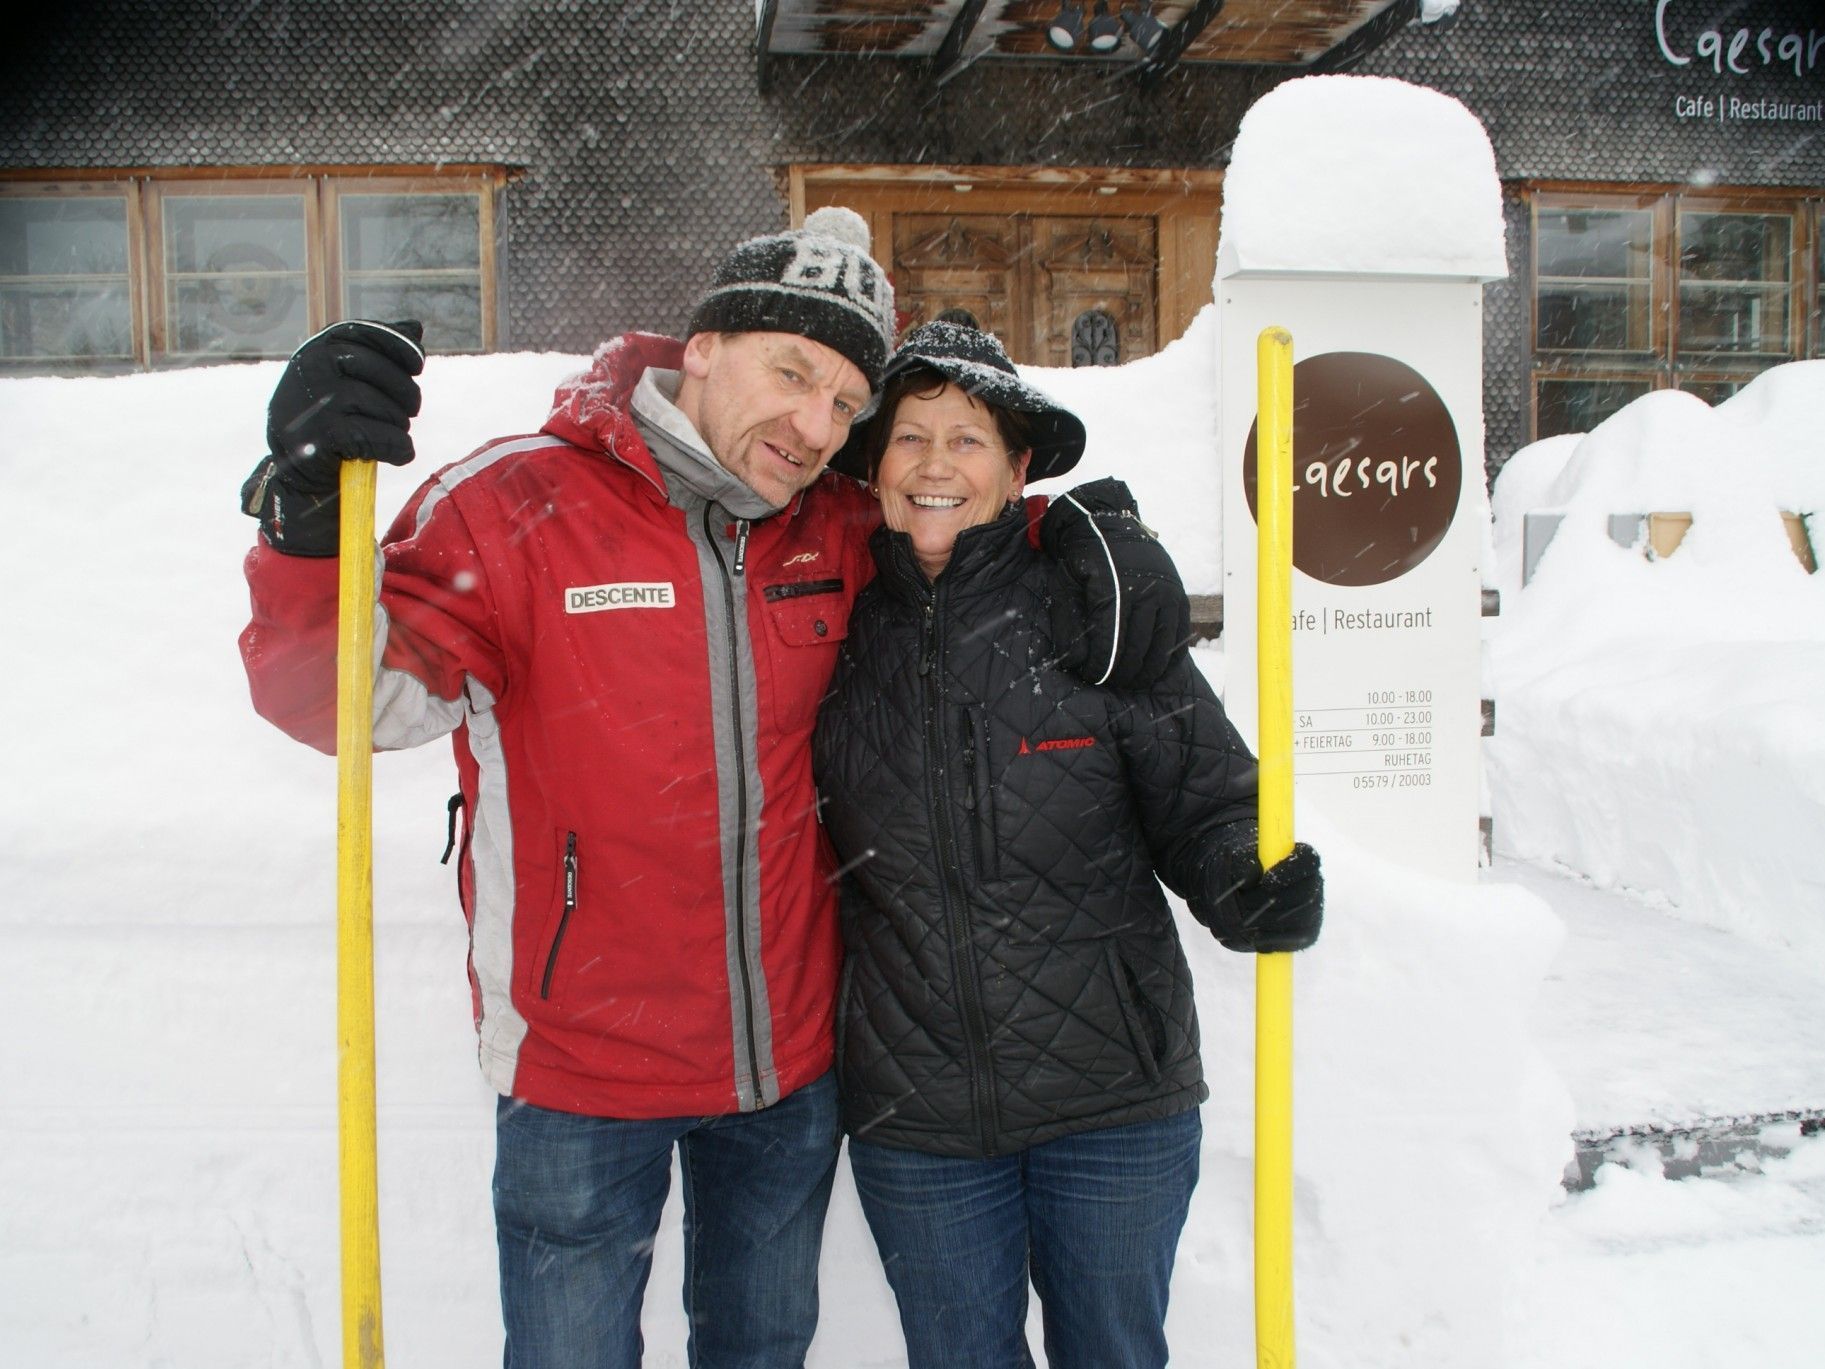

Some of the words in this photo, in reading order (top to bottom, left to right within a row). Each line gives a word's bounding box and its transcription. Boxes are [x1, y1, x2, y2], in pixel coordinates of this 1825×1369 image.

[1675, 95, 1714, 118] Cafe
[1730, 97, 1823, 121] Restaurant
[1293, 455, 1438, 497] aesars
[570, 586, 670, 609] DESCENTE
[1292, 609, 1316, 631] afe
[1334, 607, 1432, 630] Restaurant
[1367, 691, 1395, 704] 10.00
[1405, 690, 1432, 703] 18.00
[1299, 715, 1313, 728] SA
[1366, 712, 1394, 725] 10.00
[1403, 711, 1432, 724] 23.00
[1035, 736, 1095, 751] ATOMIC
[1303, 735, 1353, 749] FEIERTAG
[1372, 733, 1395, 746] 9.00
[1405, 732, 1432, 745] 18.00
[1384, 752, 1432, 766] RUHETAG
